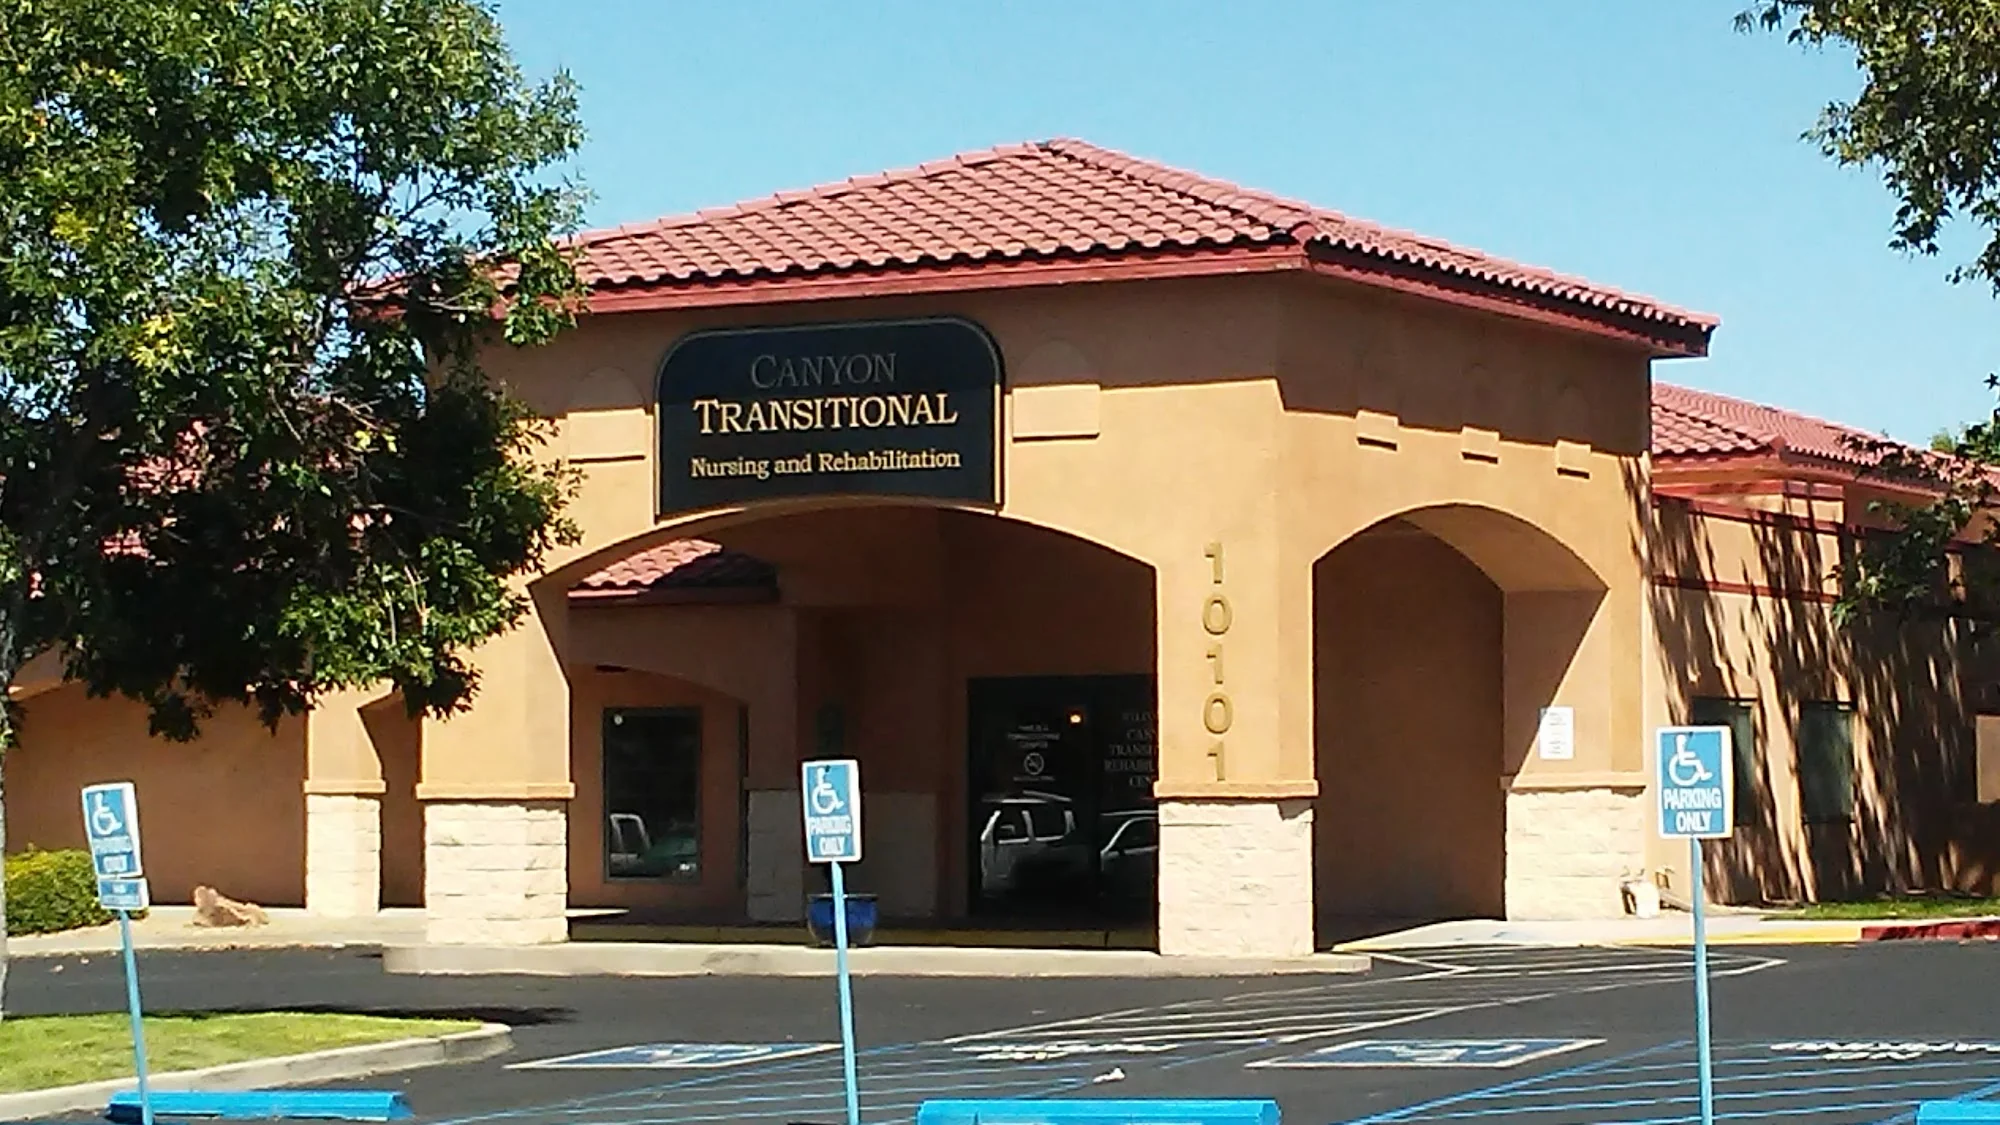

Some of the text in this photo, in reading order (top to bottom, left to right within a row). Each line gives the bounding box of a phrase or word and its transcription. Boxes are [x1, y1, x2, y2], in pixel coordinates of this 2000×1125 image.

[751, 352, 897, 389] CANYON
[692, 394, 959, 435] TRANSITIONAL
[690, 449, 962, 480] Nursing and Rehabilitation
[1203, 542, 1233, 782] 10101
[1663, 788, 1722, 809] PARKING
[1676, 811, 1712, 832] ONLY
